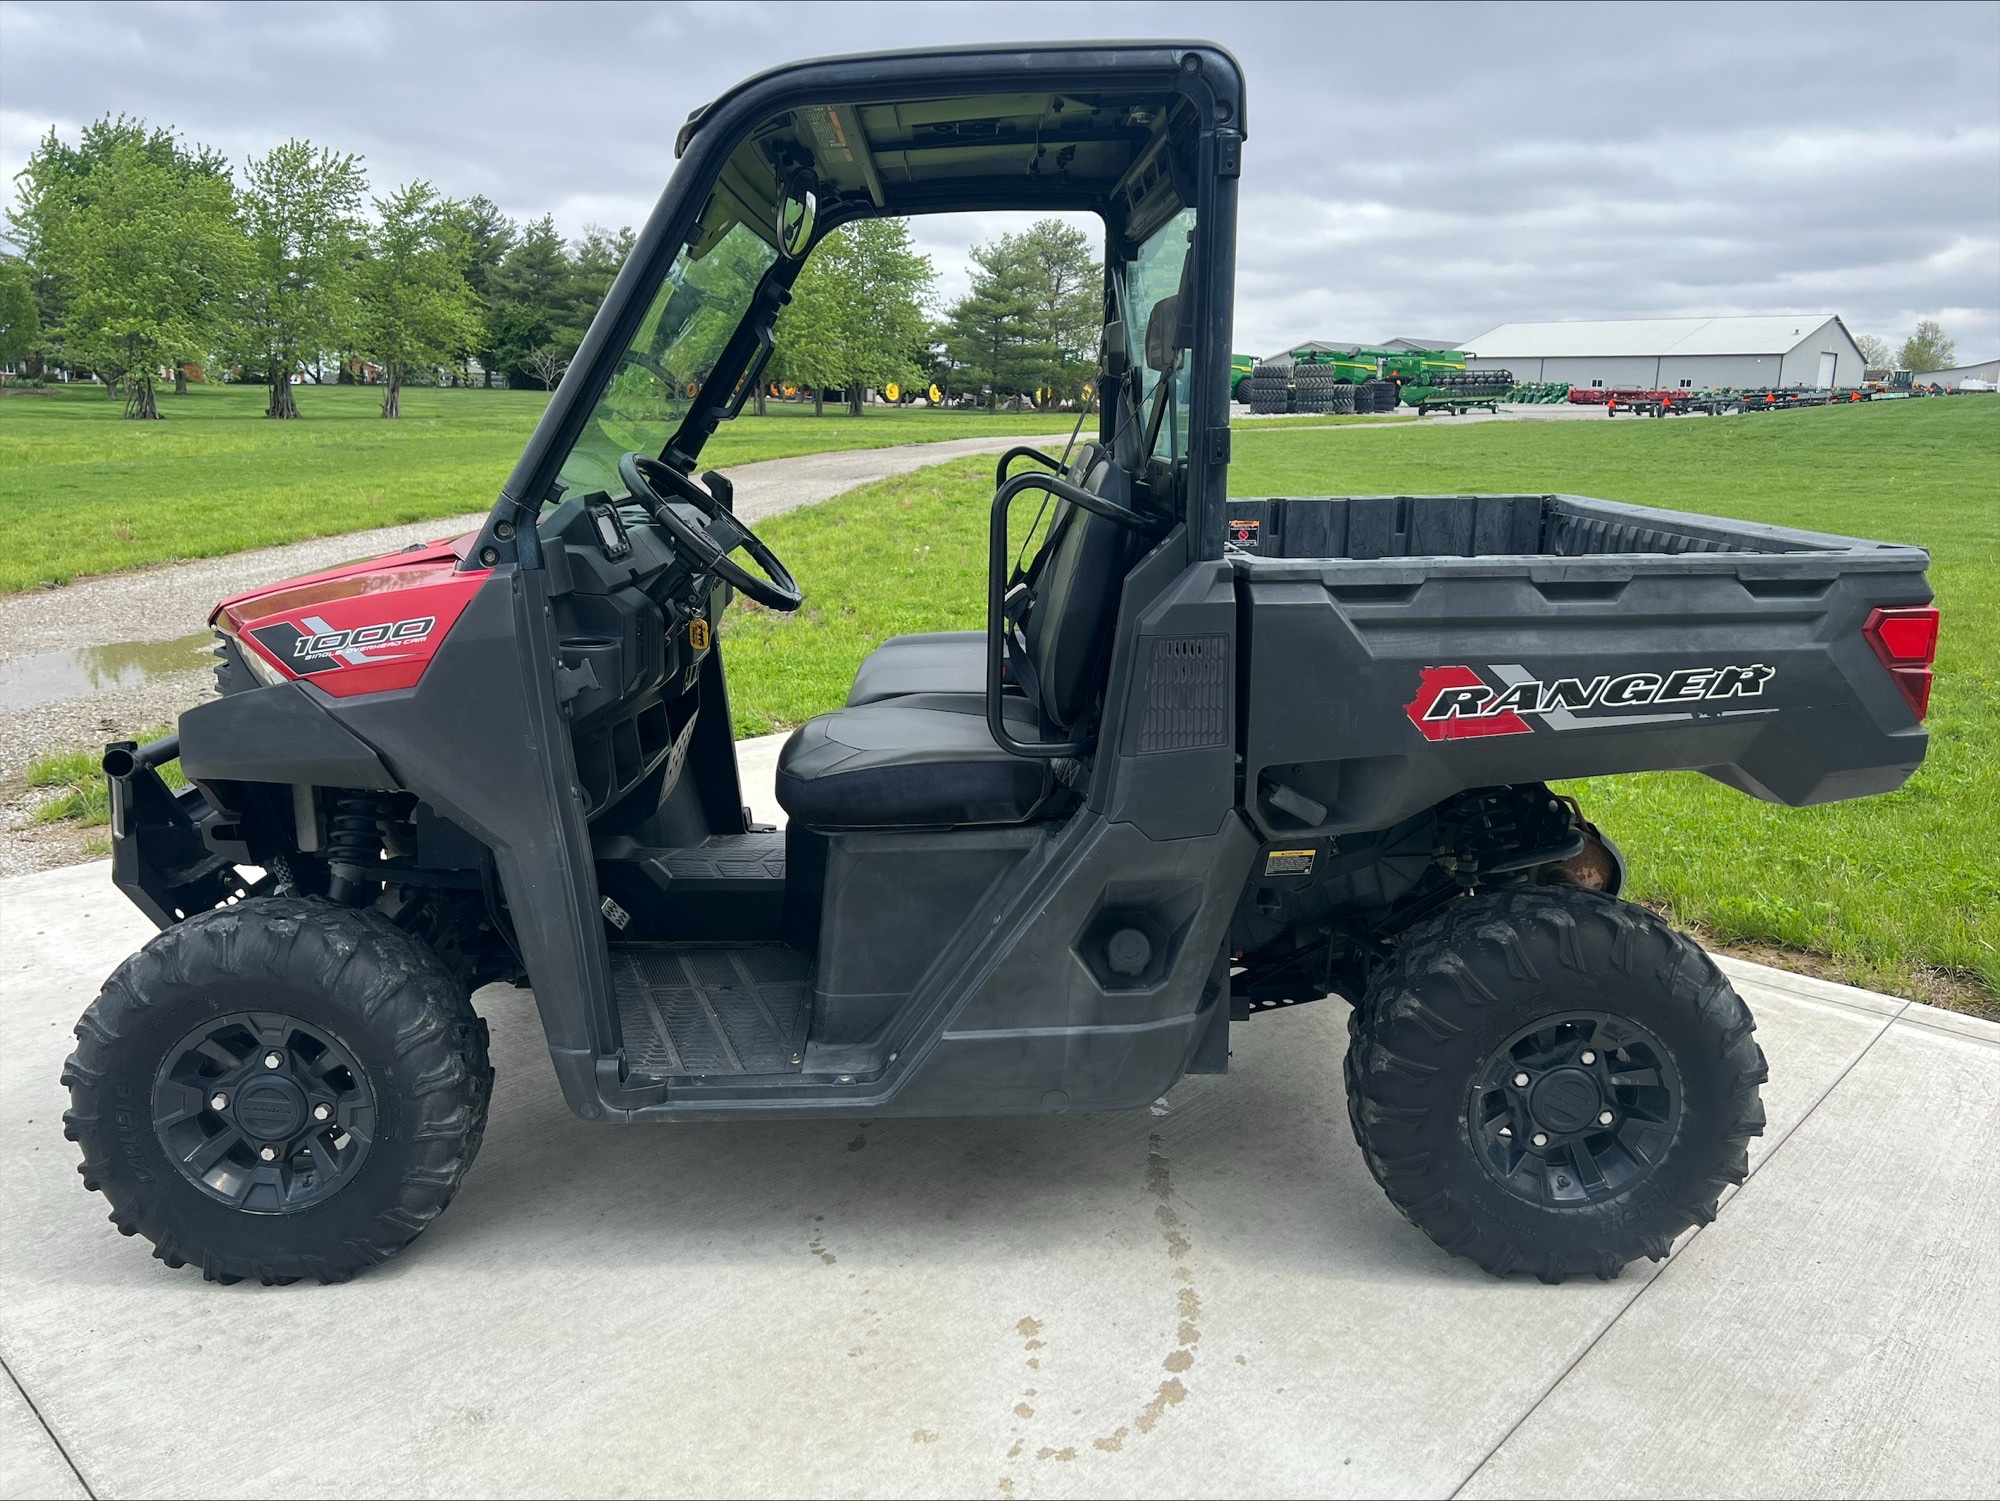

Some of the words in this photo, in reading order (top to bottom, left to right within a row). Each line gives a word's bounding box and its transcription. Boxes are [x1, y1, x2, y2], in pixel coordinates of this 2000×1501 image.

[294, 616, 436, 657] 1000
[305, 649, 342, 661] SINGLE
[345, 640, 401, 654] OVERHEAD
[403, 636, 428, 645] CAM
[1422, 664, 1776, 721] RANGER
